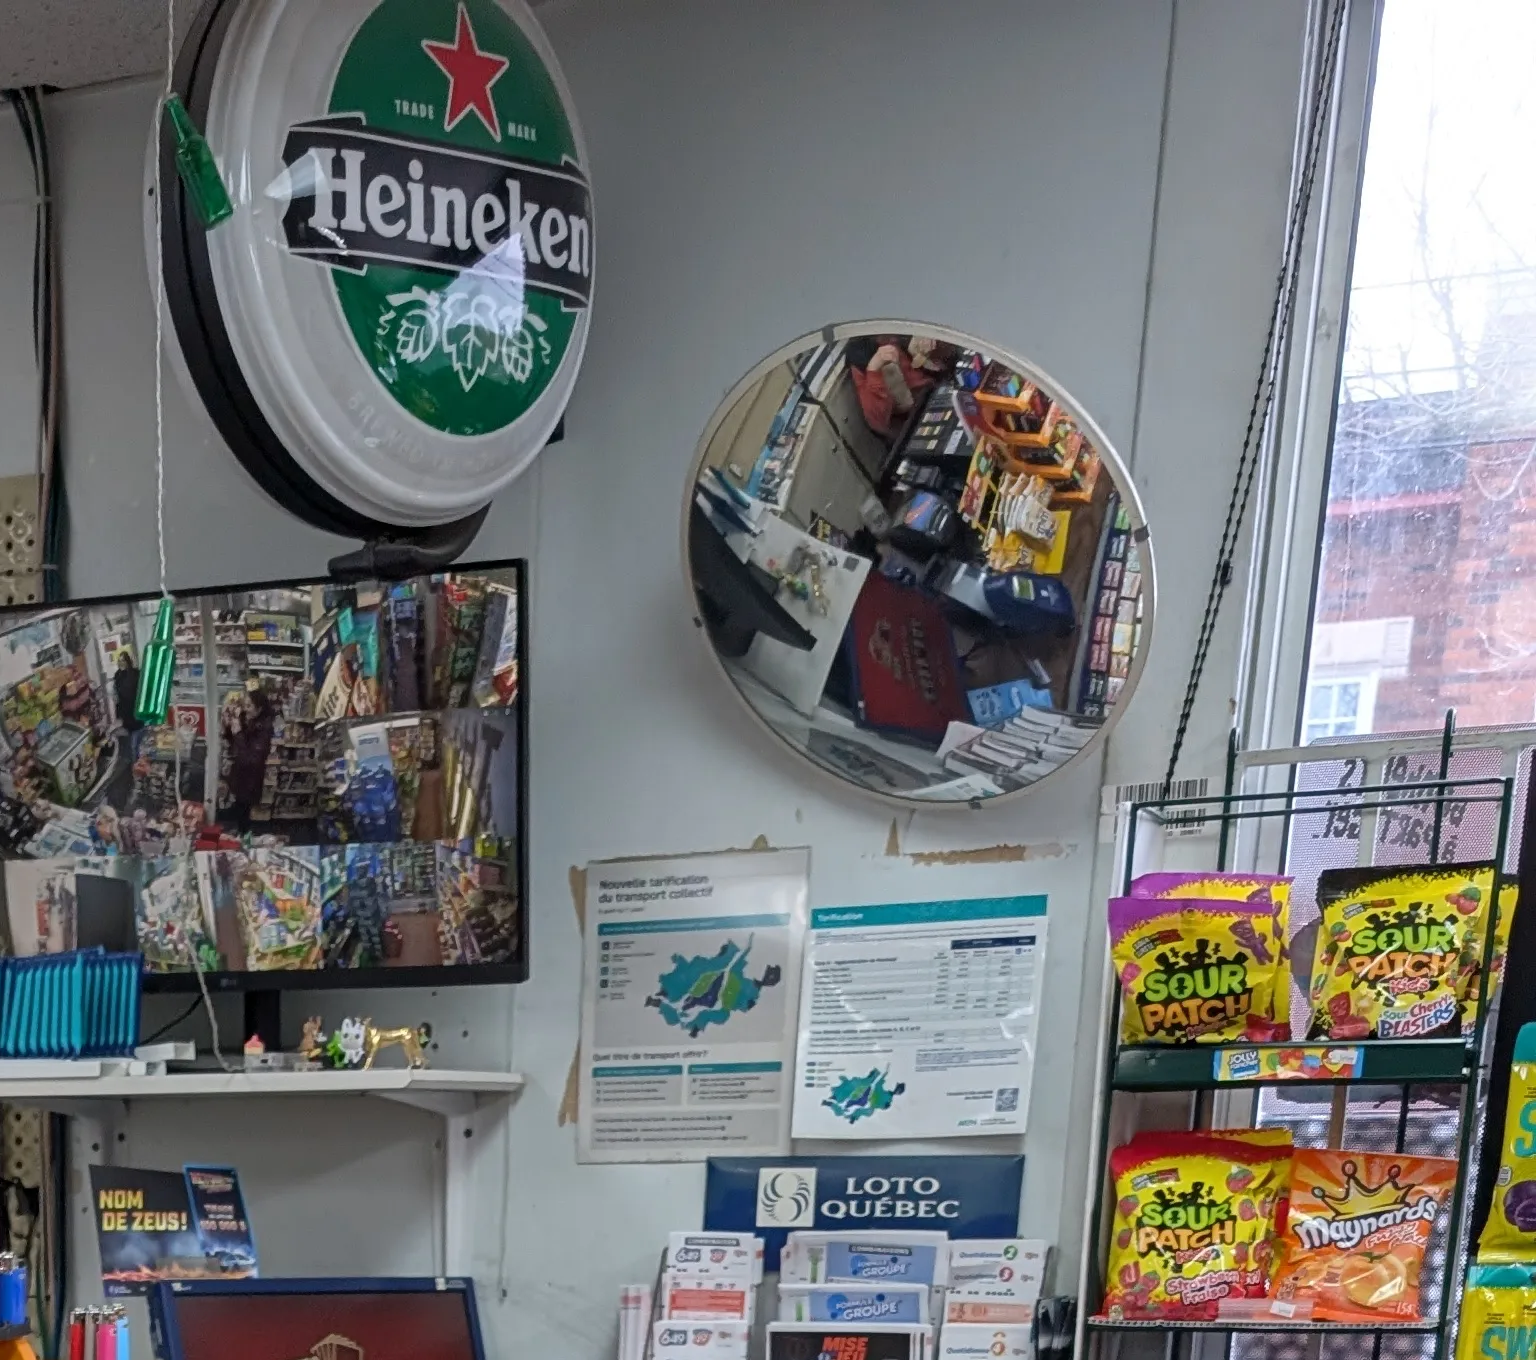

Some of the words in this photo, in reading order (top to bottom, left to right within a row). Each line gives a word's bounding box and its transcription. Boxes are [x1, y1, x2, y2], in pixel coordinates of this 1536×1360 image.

[395, 99, 434, 120] TRADE
[508, 121, 537, 142] MARK
[308, 147, 590, 277] Heineken
[598, 893, 612, 903] du
[615, 890, 666, 903] transport
[669, 886, 713, 899] collectif
[599, 878, 646, 889] Nouvelle
[649, 875, 709, 888] tarification
[1352, 922, 1455, 956] SOUR
[1348, 951, 1459, 982] PATCH
[1144, 962, 1247, 1001] SOUR
[1141, 998, 1252, 1032] PATCH
[1380, 1010, 1457, 1039] BLASTERS
[99, 1189, 144, 1210] NOM
[846, 1175, 940, 1196] LOTO
[102, 1211, 128, 1232] DE
[132, 1211, 188, 1232] ZEUS!
[820, 1196, 961, 1220] QUÉBEC
[1141, 1200, 1232, 1230] SOUR
[1295, 1196, 1439, 1249] Maynards
[1137, 1221, 1237, 1253] PATCH
[843, 1303, 898, 1320] GROUPE
[822, 1336, 869, 1351] MISE
